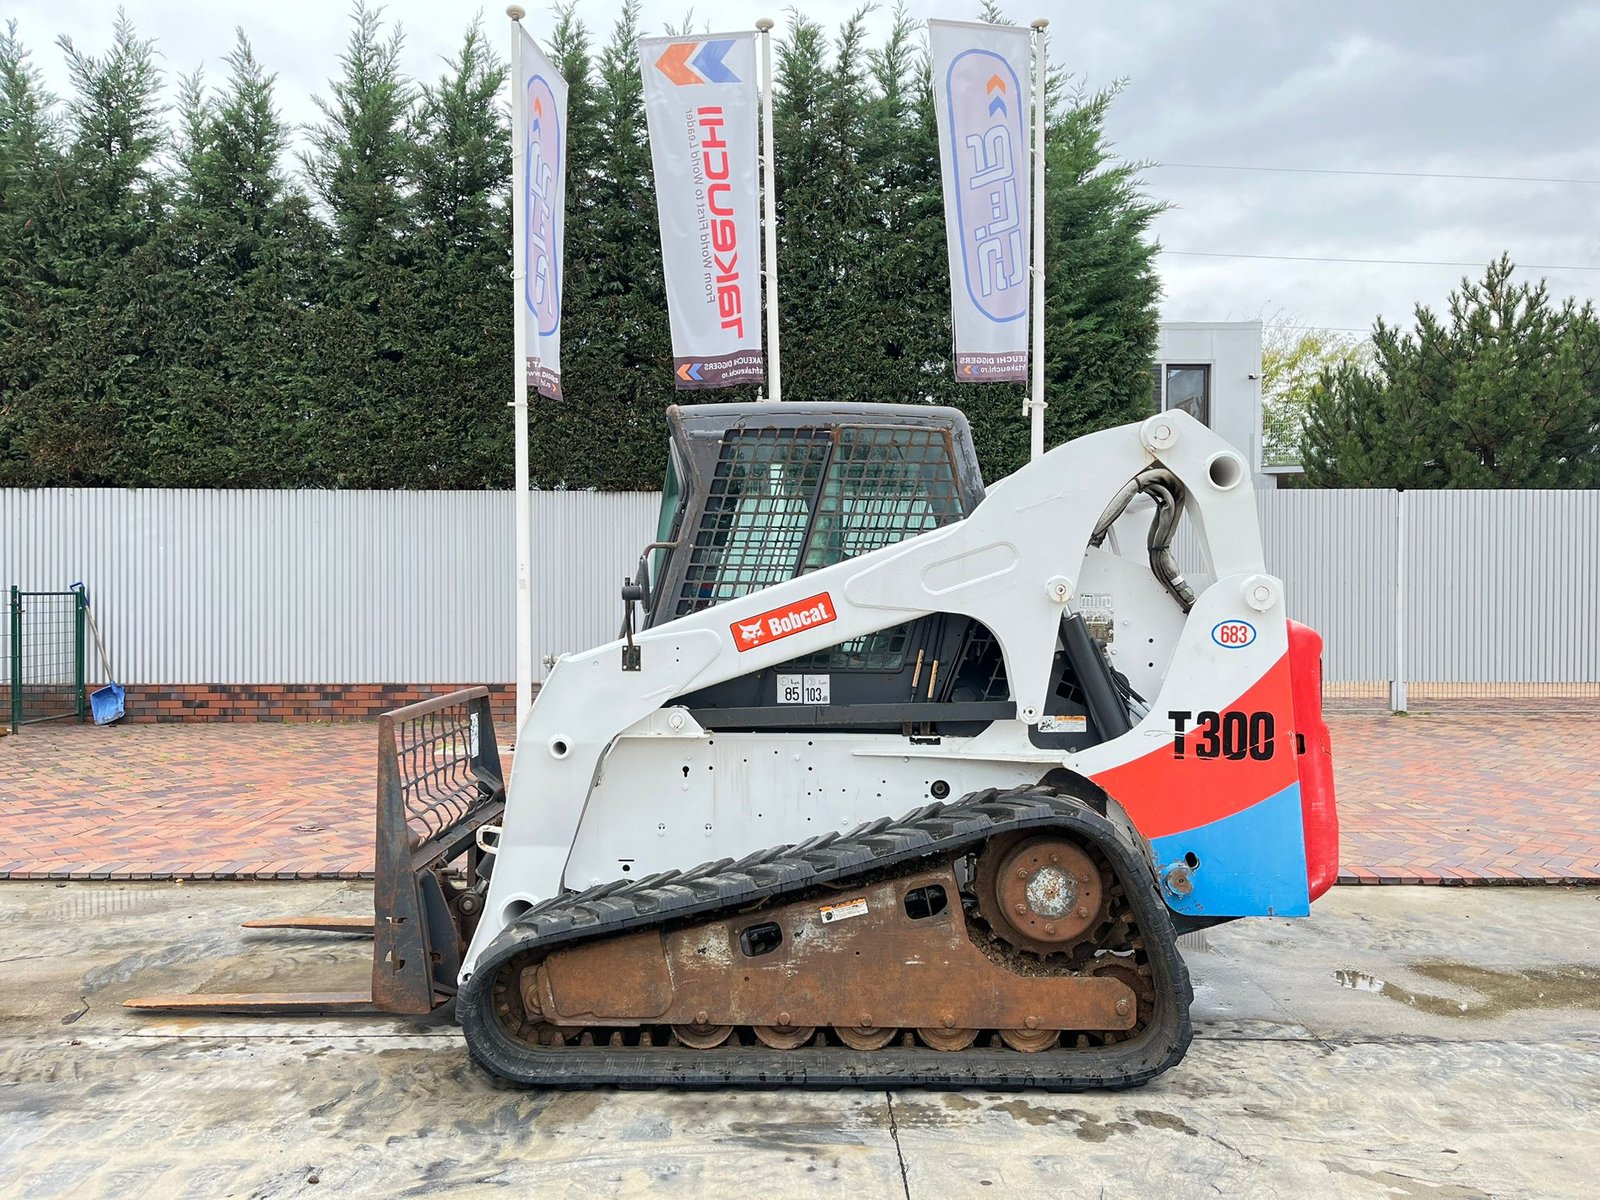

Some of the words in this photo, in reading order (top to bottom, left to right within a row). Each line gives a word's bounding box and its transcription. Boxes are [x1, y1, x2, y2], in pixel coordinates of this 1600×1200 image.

[767, 602, 829, 637] Bobcat
[1220, 625, 1248, 644] 683
[785, 686, 800, 702] 85
[805, 687, 822, 702] 103
[1168, 710, 1275, 761] T300
